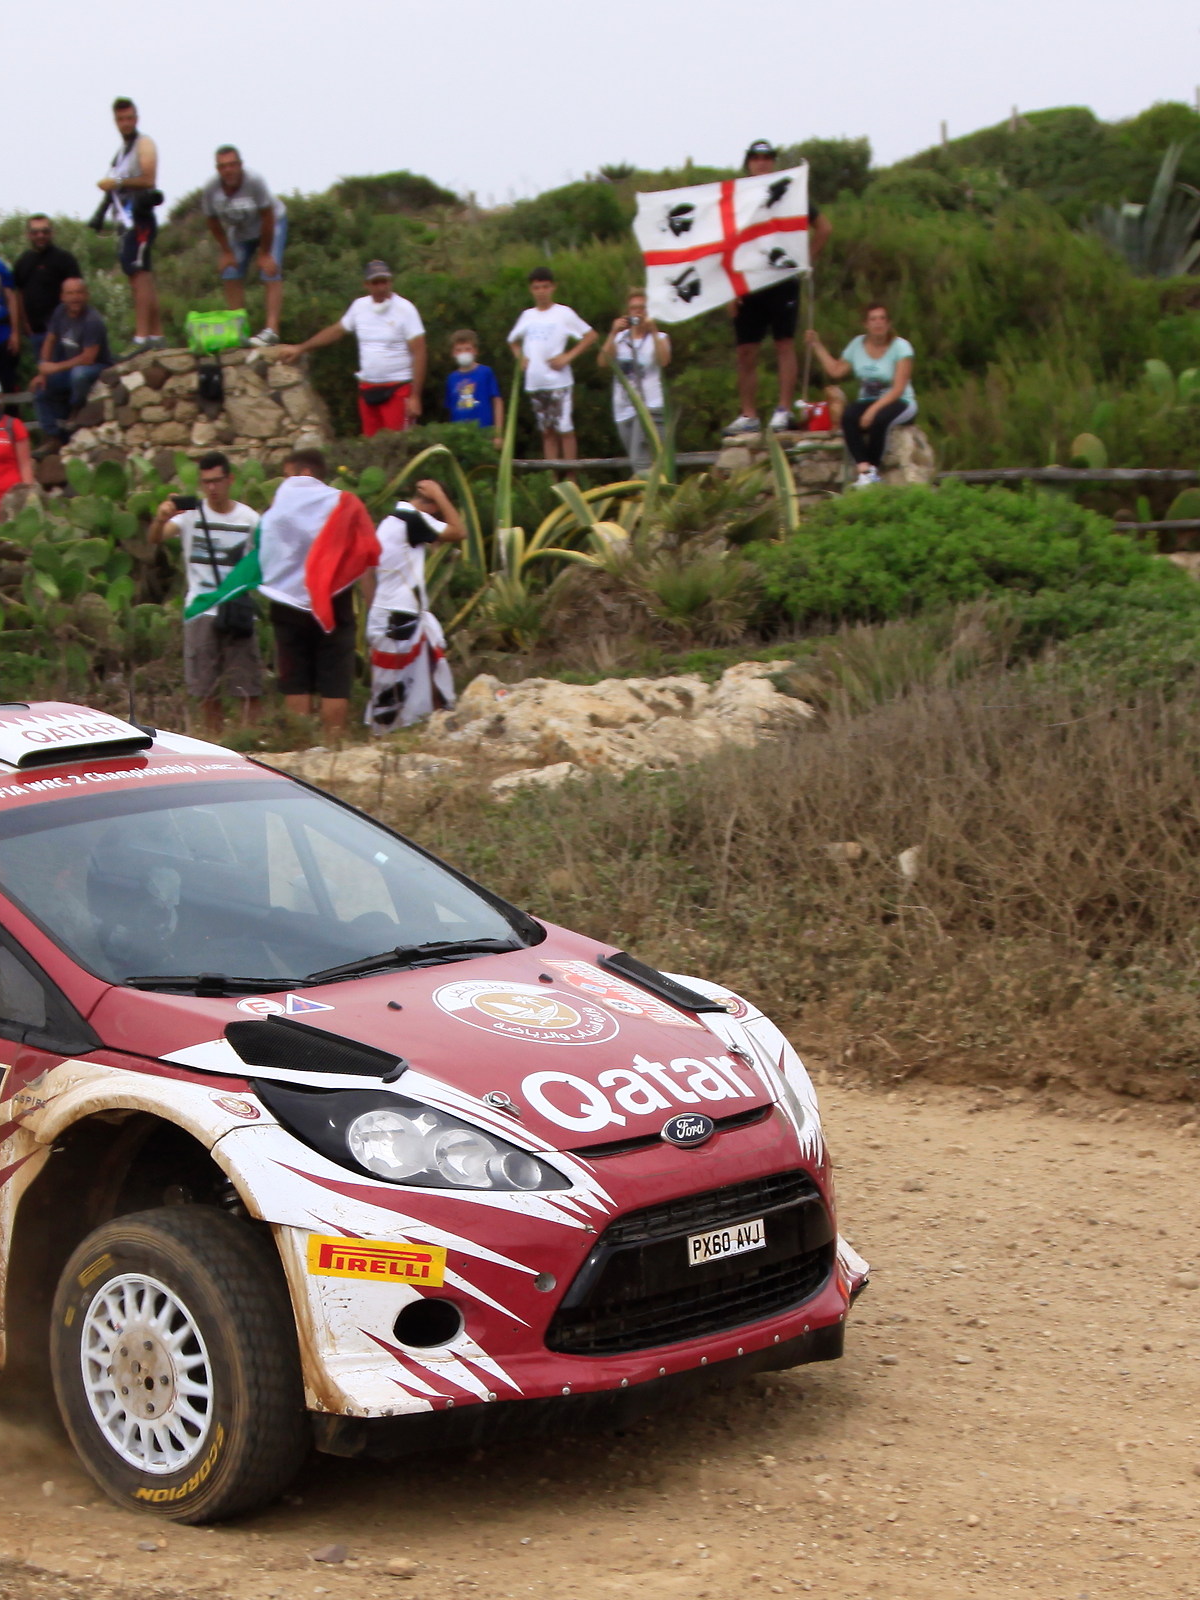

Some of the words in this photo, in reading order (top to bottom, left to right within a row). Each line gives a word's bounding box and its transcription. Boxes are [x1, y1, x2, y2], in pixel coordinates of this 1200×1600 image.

[21, 721, 127, 745] QATAR
[23, 776, 71, 794] WRC
[67, 774, 87, 786] 2
[83, 764, 197, 785] Championship
[244, 1001, 278, 1014] E
[521, 1053, 756, 1133] Qatar
[676, 1117, 706, 1139] Ford
[693, 1232, 731, 1260] PX60
[736, 1223, 761, 1249] AVJ
[318, 1243, 433, 1280] PIRELLI
[133, 1422, 225, 1503] SCORPION
